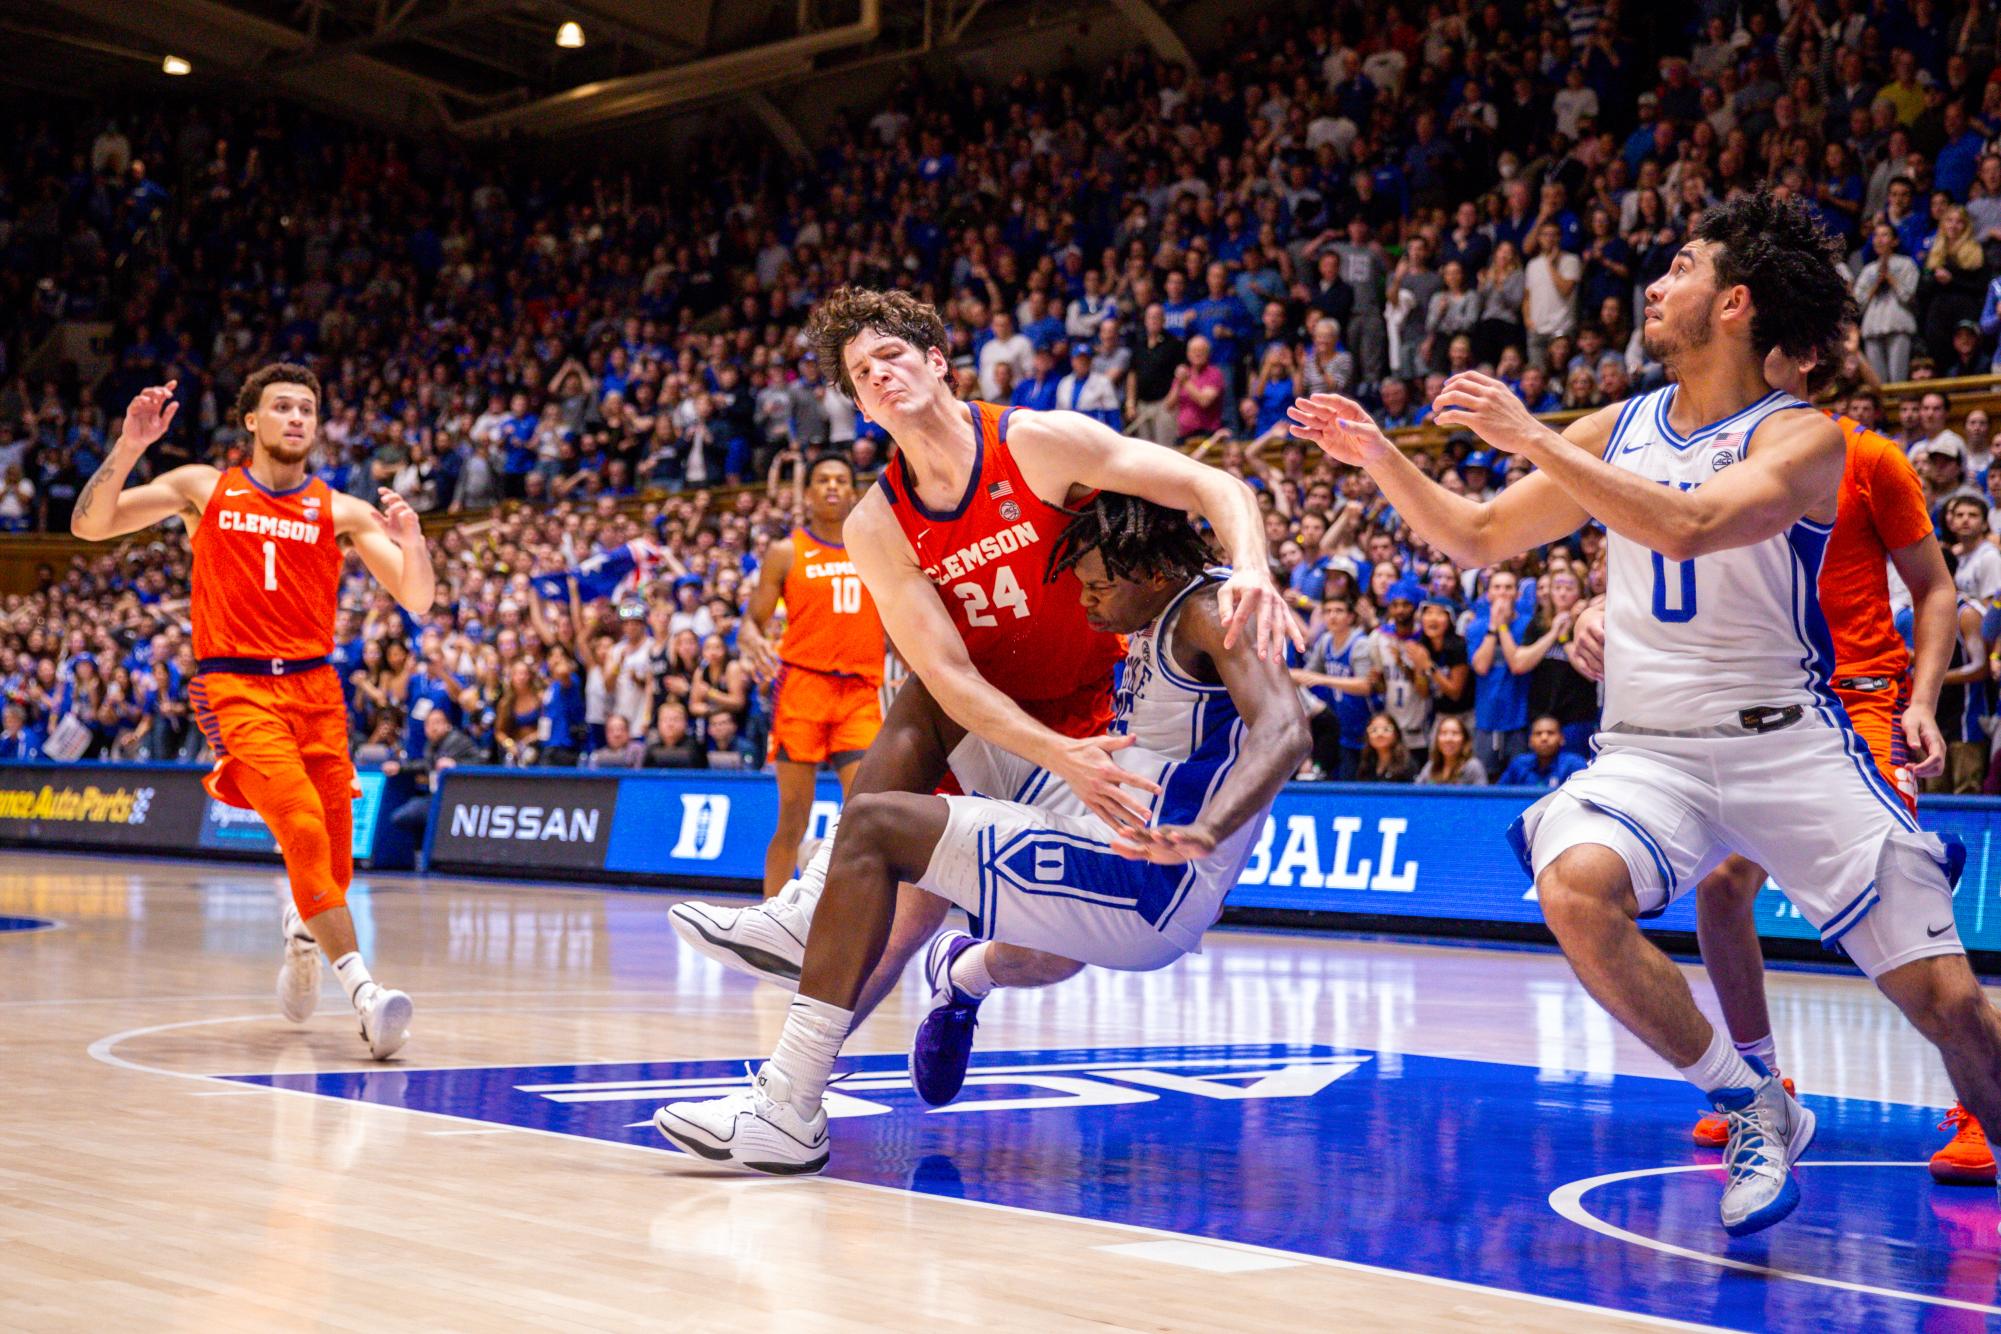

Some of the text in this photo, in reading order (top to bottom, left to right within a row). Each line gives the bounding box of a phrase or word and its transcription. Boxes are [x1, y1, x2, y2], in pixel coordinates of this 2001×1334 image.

[218, 510, 320, 545] CLEMSON
[262, 540, 278, 592] 1
[831, 576, 862, 614] 10
[953, 565, 1031, 628] 24
[1651, 549, 1698, 623] 0
[271, 658, 285, 675] C
[451, 804, 599, 843] NISSAN
